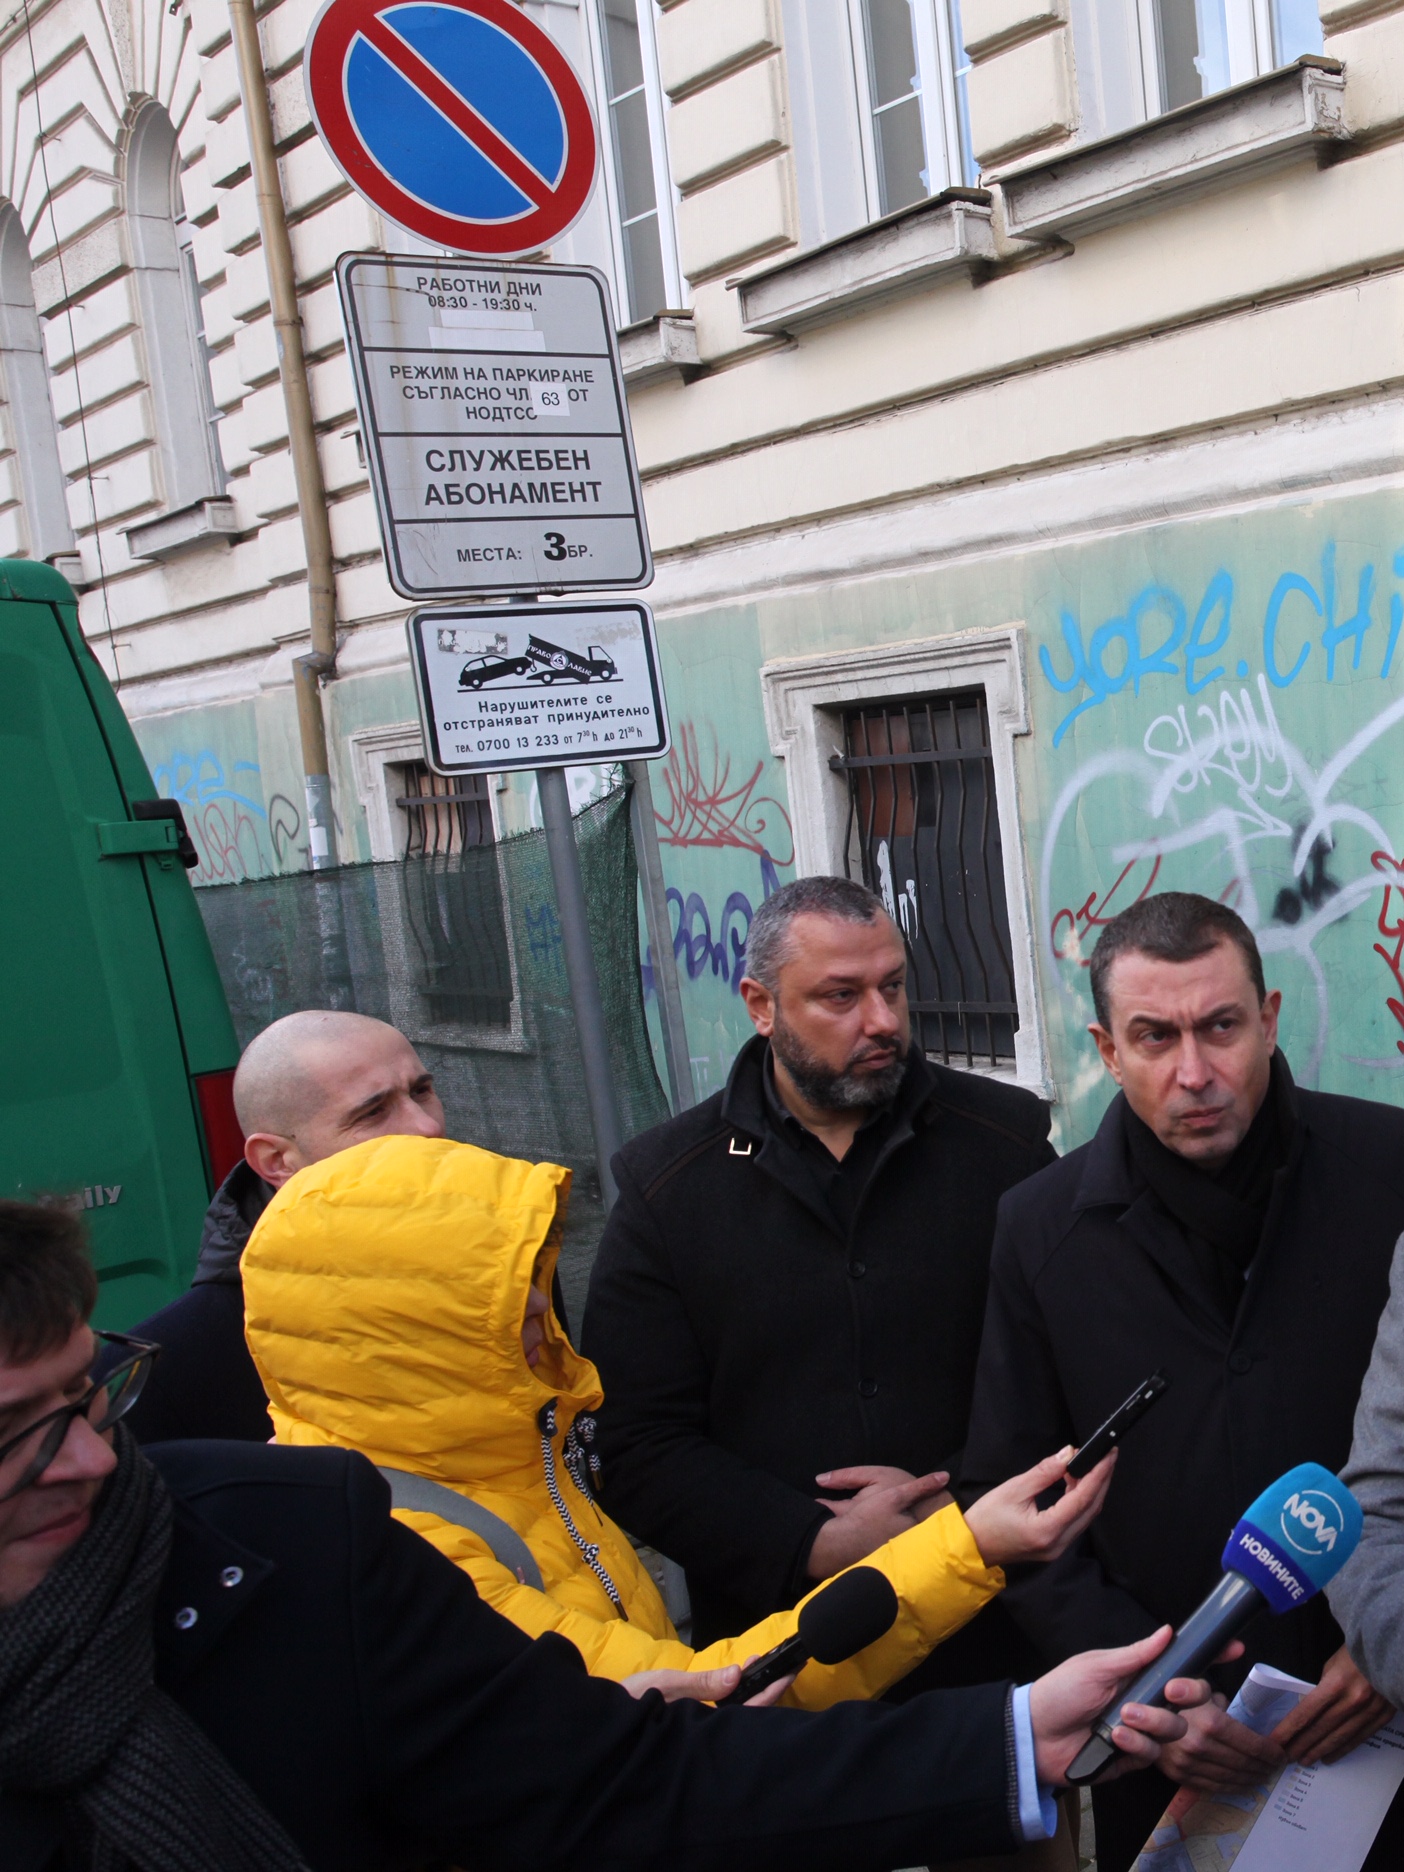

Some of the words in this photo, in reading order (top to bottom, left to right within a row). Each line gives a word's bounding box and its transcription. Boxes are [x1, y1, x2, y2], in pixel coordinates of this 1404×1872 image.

[417, 276, 501, 295] РАБОТНИ
[507, 281, 542, 297] ДНИ
[427, 295, 468, 309] 08:30
[482, 297, 520, 311] 19:30
[524, 300, 537, 312] ч.
[390, 365, 458, 380] РЕЖИМ
[464, 367, 488, 381] НА
[493, 367, 594, 383] ПАРКИРАНЕ
[402, 386, 501, 400] СЪГЛАСНО
[541, 391, 560, 406] 63
[567, 388, 588, 402] ОТ
[425, 449, 591, 472] СЛУЖЕБЕН
[424, 481, 602, 506] АБОНАМЕНТ
[457, 547, 522, 562] МЕСТА:
[478, 695, 588, 714] Нарушителите
[596, 694, 613, 704] се
[443, 715, 539, 731] отстраняват
[547, 706, 650, 725] принудително
[455, 743, 474, 754] тел.
[477, 737, 510, 752] 0700
[517, 736, 529, 748] 13
[535, 734, 559, 747] 233
[563, 735, 574, 744] от
[604, 732, 615, 743] до
[1283, 1493, 1338, 1552] NOVA
[1239, 1533, 1305, 1600] НОВИНИТЕ
